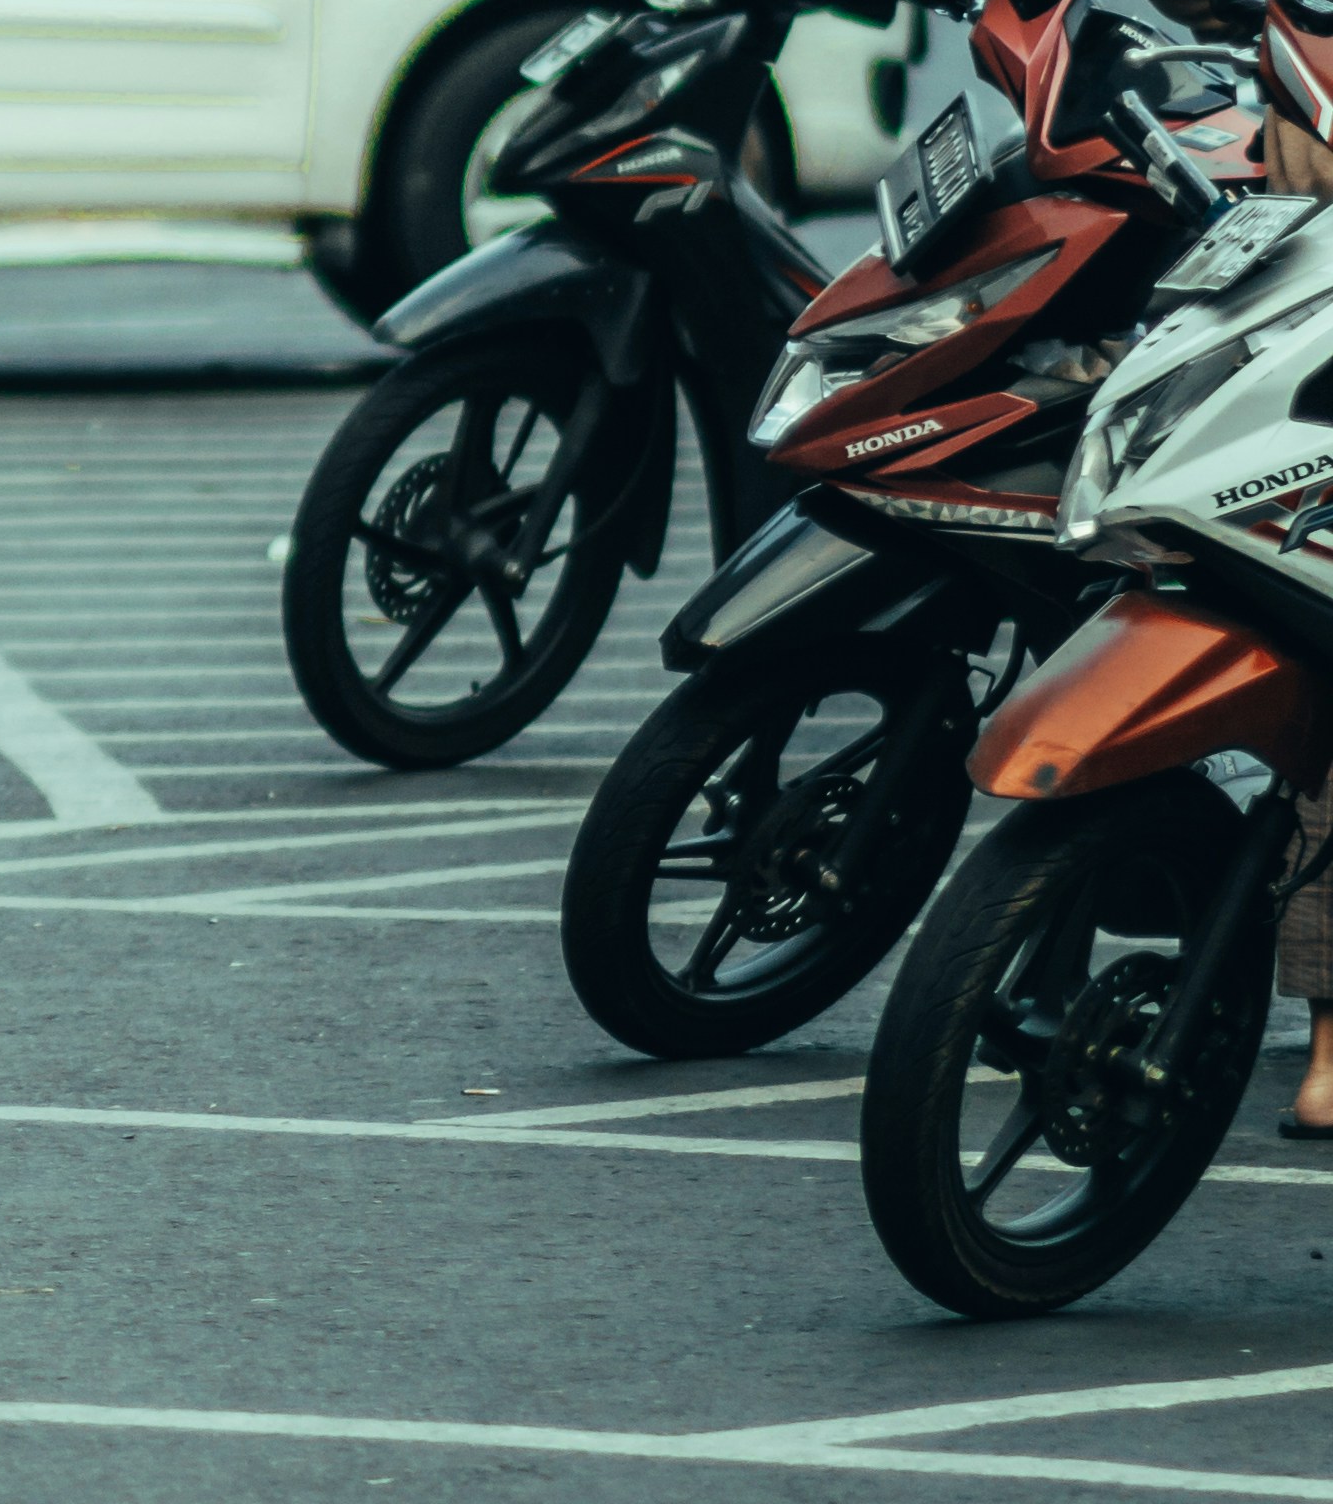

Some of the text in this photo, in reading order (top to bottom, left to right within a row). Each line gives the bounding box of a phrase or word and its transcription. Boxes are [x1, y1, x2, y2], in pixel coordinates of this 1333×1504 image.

[1118, 24, 1156, 49] HOND
[845, 419, 944, 459] HONDA
[1213, 454, 1333, 510] HONDA
